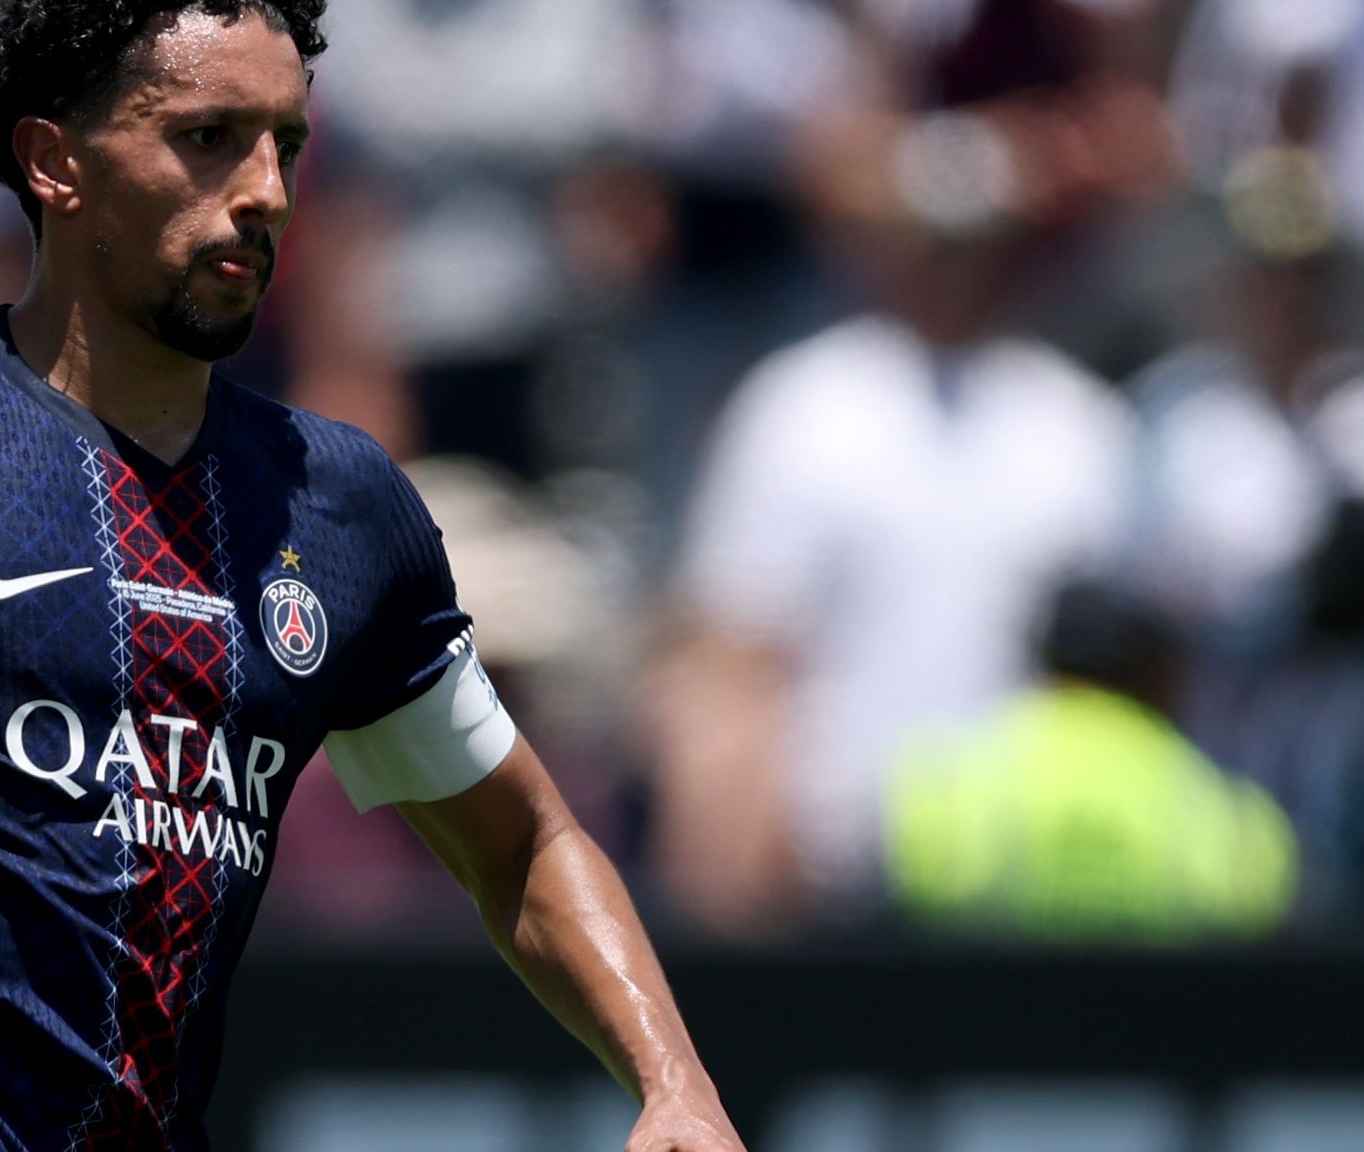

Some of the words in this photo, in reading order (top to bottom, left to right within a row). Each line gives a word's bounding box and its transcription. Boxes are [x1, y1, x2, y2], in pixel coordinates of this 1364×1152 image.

[268, 584, 316, 610] PARIS
[5, 698, 286, 819] QATAR
[92, 792, 268, 877] AIRWAYS
